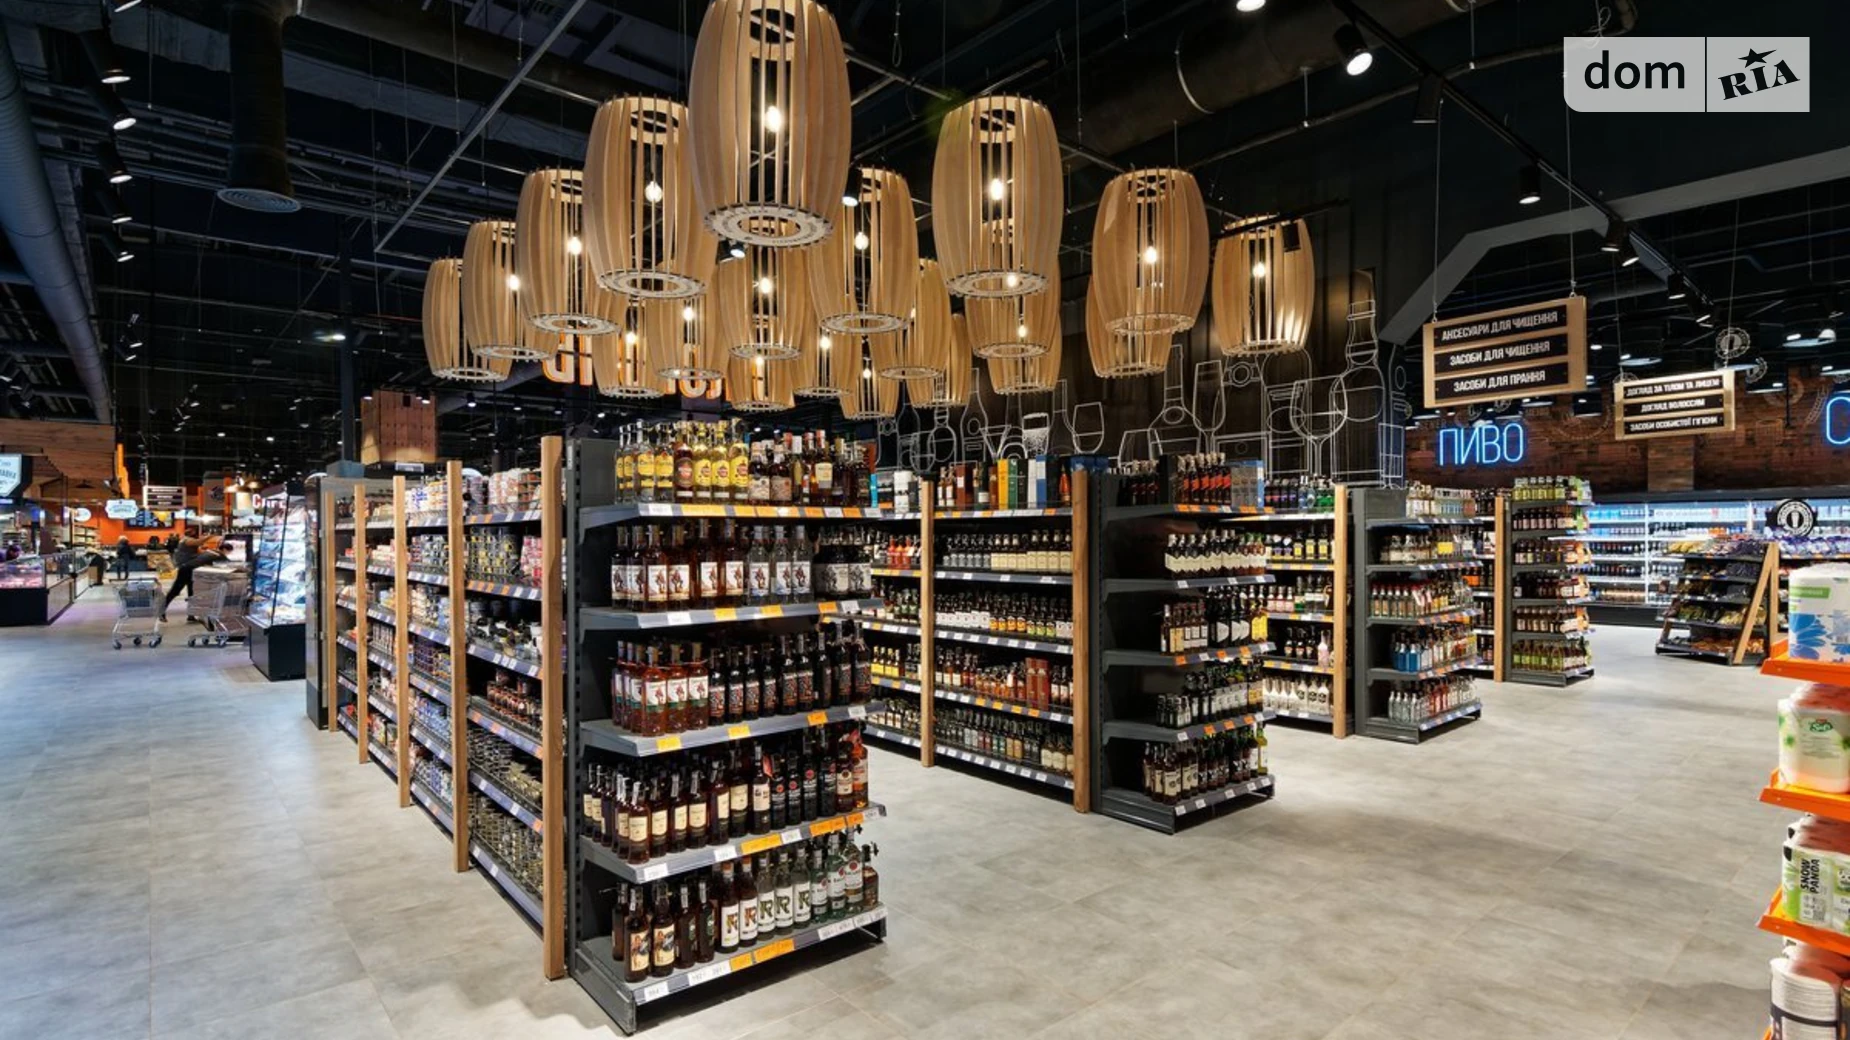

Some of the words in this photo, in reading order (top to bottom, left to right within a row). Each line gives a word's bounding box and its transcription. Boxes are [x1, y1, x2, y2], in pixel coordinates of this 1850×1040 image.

[1442, 324, 1490, 340] АКСЕСУАРИ
[1491, 320, 1512, 333] ДЛЯ
[1513, 312, 1558, 328] ЧИЩЕННЯ
[1450, 351, 1482, 366] ЗАСОБИ
[1484, 348, 1504, 362] ДЛЯ
[1505, 341, 1550, 356] ЧИЩЕННЯ
[1454, 378, 1487, 392] ЗАСОБИ
[1488, 375, 1508, 389] ДЛЯ
[1510, 370, 1545, 386] ПРАННЯ
[1627, 386, 1653, 396] ДОГЛЯД
[1654, 384, 1663, 392] ЗА
[1686, 381, 1693, 389] ТА
[1642, 402, 1667, 412] ДОГЛЯД
[1631, 422, 1654, 431] ЗАСОБИ
[1439, 422, 1524, 466] ПИВО
[1801, 859, 1810, 890] SNOW
[1810, 859, 1819, 894] PANDA
